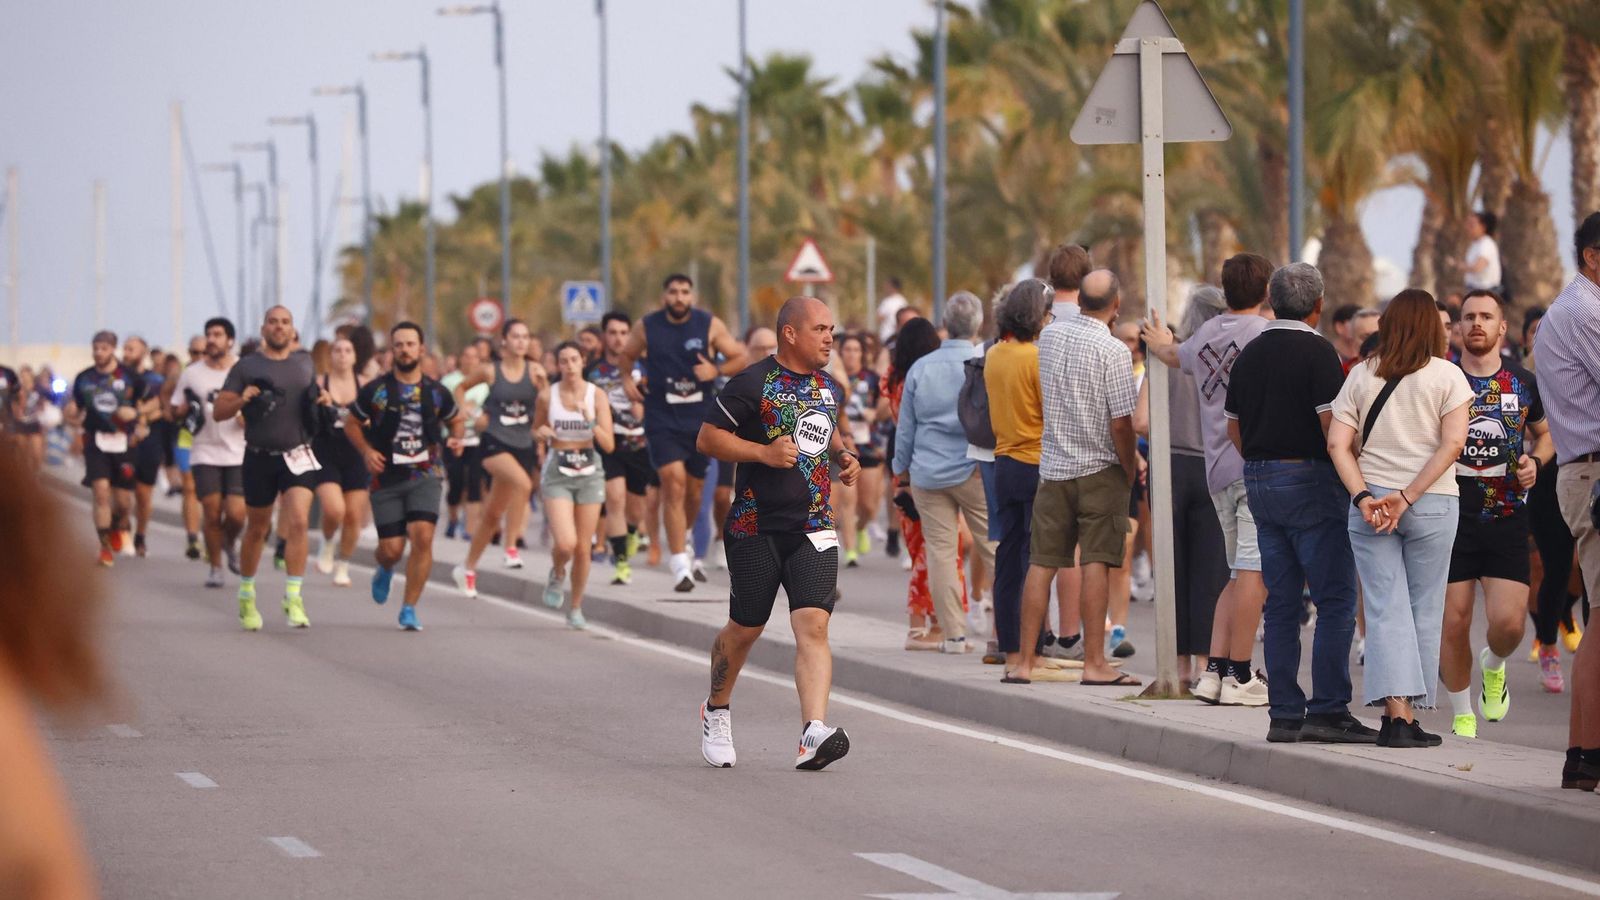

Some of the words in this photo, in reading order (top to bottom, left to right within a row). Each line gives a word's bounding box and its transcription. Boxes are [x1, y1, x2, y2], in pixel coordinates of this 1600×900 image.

[801, 420, 829, 437] PONLE
[798, 429, 826, 445] FRENO
[1463, 446, 1499, 457] 1048
